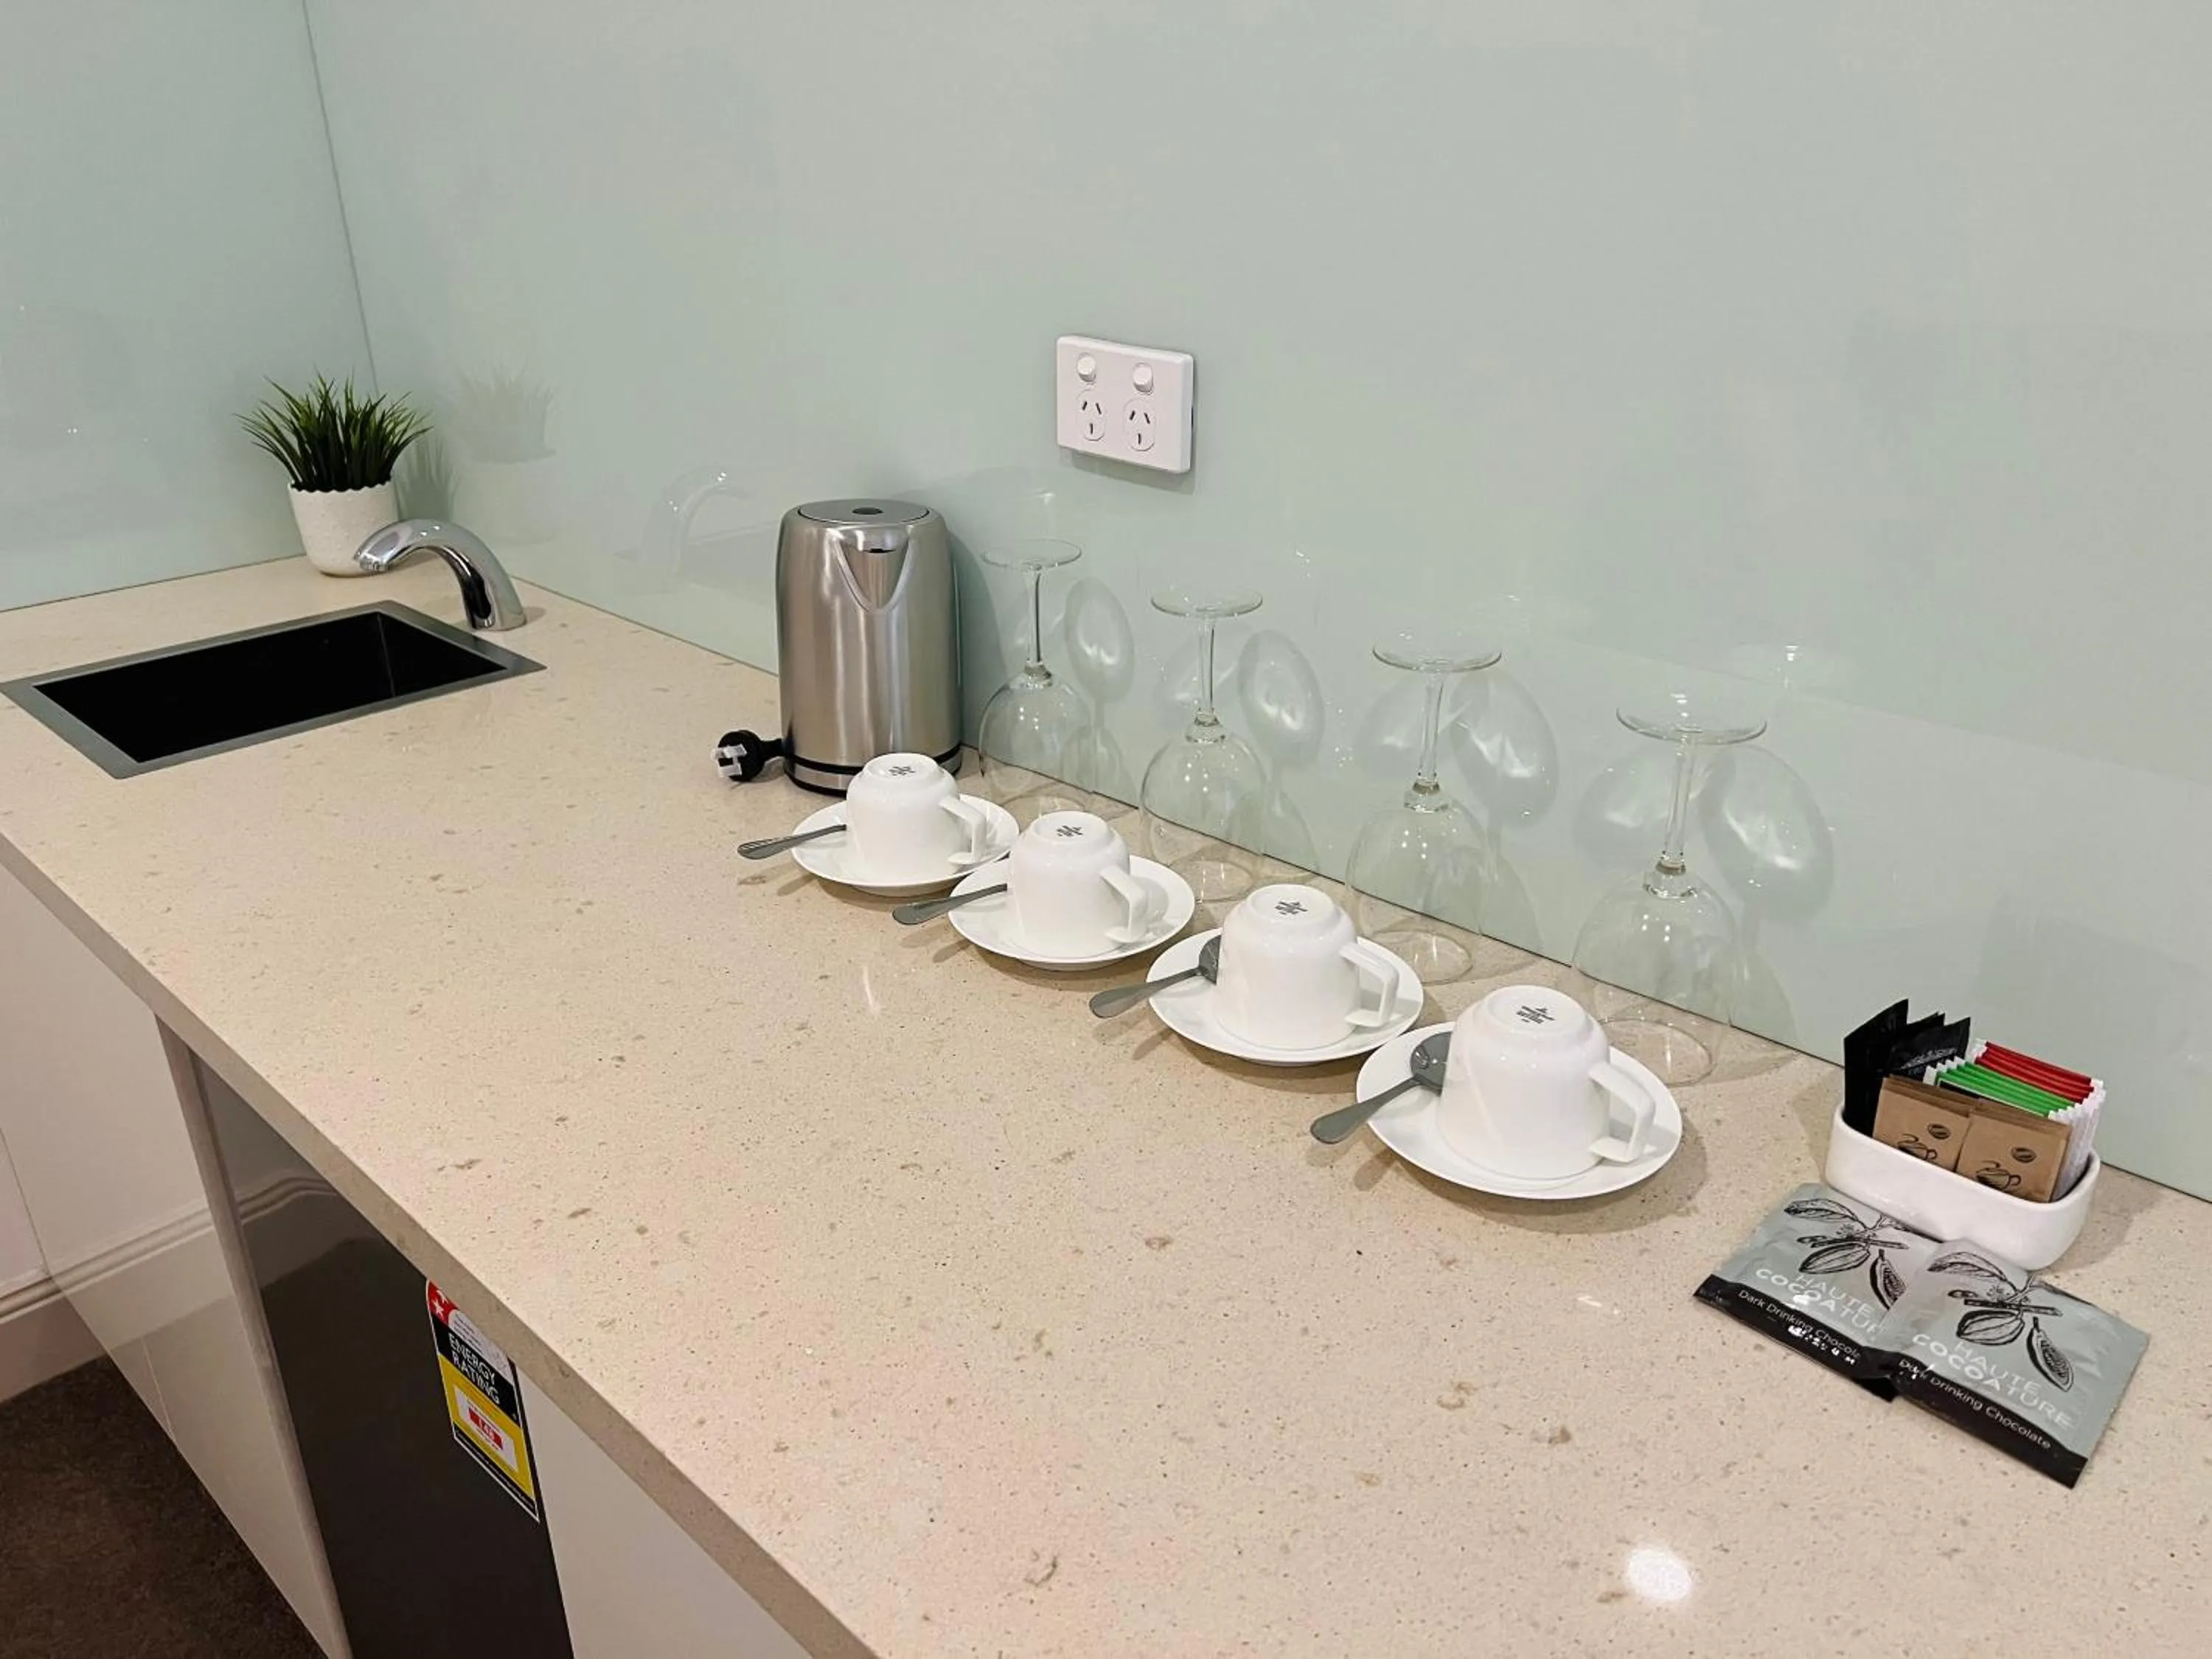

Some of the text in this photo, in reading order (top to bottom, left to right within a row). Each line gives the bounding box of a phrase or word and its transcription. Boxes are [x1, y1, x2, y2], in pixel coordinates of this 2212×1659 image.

[1738, 1290, 1765, 1307] Dark
[1766, 1303, 1813, 1333] Drinking
[1756, 1268, 1877, 1334] COCOATU
[1795, 1275, 1874, 1318] HAUTE
[448, 1332, 495, 1385] ENERGY
[452, 1351, 500, 1405] RATING
[1913, 1333, 2076, 1430] COCOATURE
[1955, 1341, 2041, 1393] HAUTE
[1930, 1377, 1983, 1411] Drinking
[1985, 1405, 2052, 1450] Chocolate
